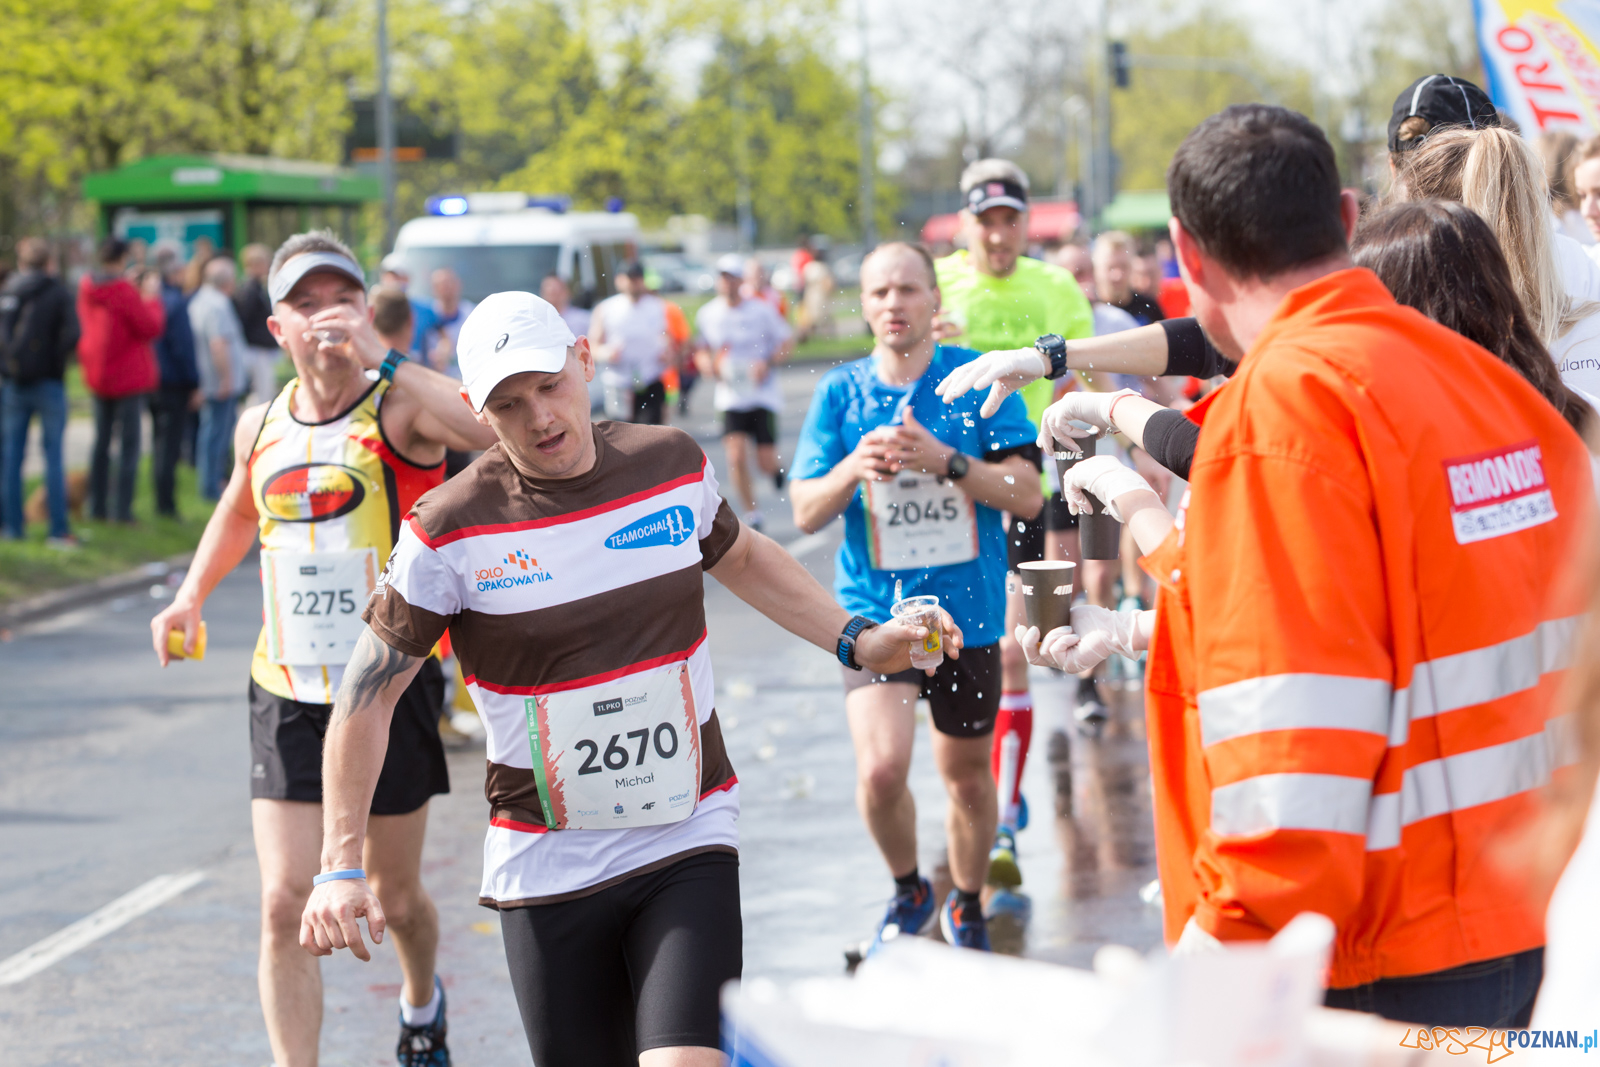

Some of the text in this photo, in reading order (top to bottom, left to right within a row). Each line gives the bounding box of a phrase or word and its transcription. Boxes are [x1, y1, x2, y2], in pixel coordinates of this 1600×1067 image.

[1554, 358, 1600, 373] ularny
[887, 497, 957, 527] 2045
[610, 519, 668, 548] TEAMOCHAL
[475, 567, 503, 581] SOLO
[477, 572, 553, 592] OPAKOWANIA
[291, 589, 356, 615] 2275
[606, 702, 621, 711] PKO
[574, 722, 678, 775] 2670
[615, 772, 655, 788] Michał
